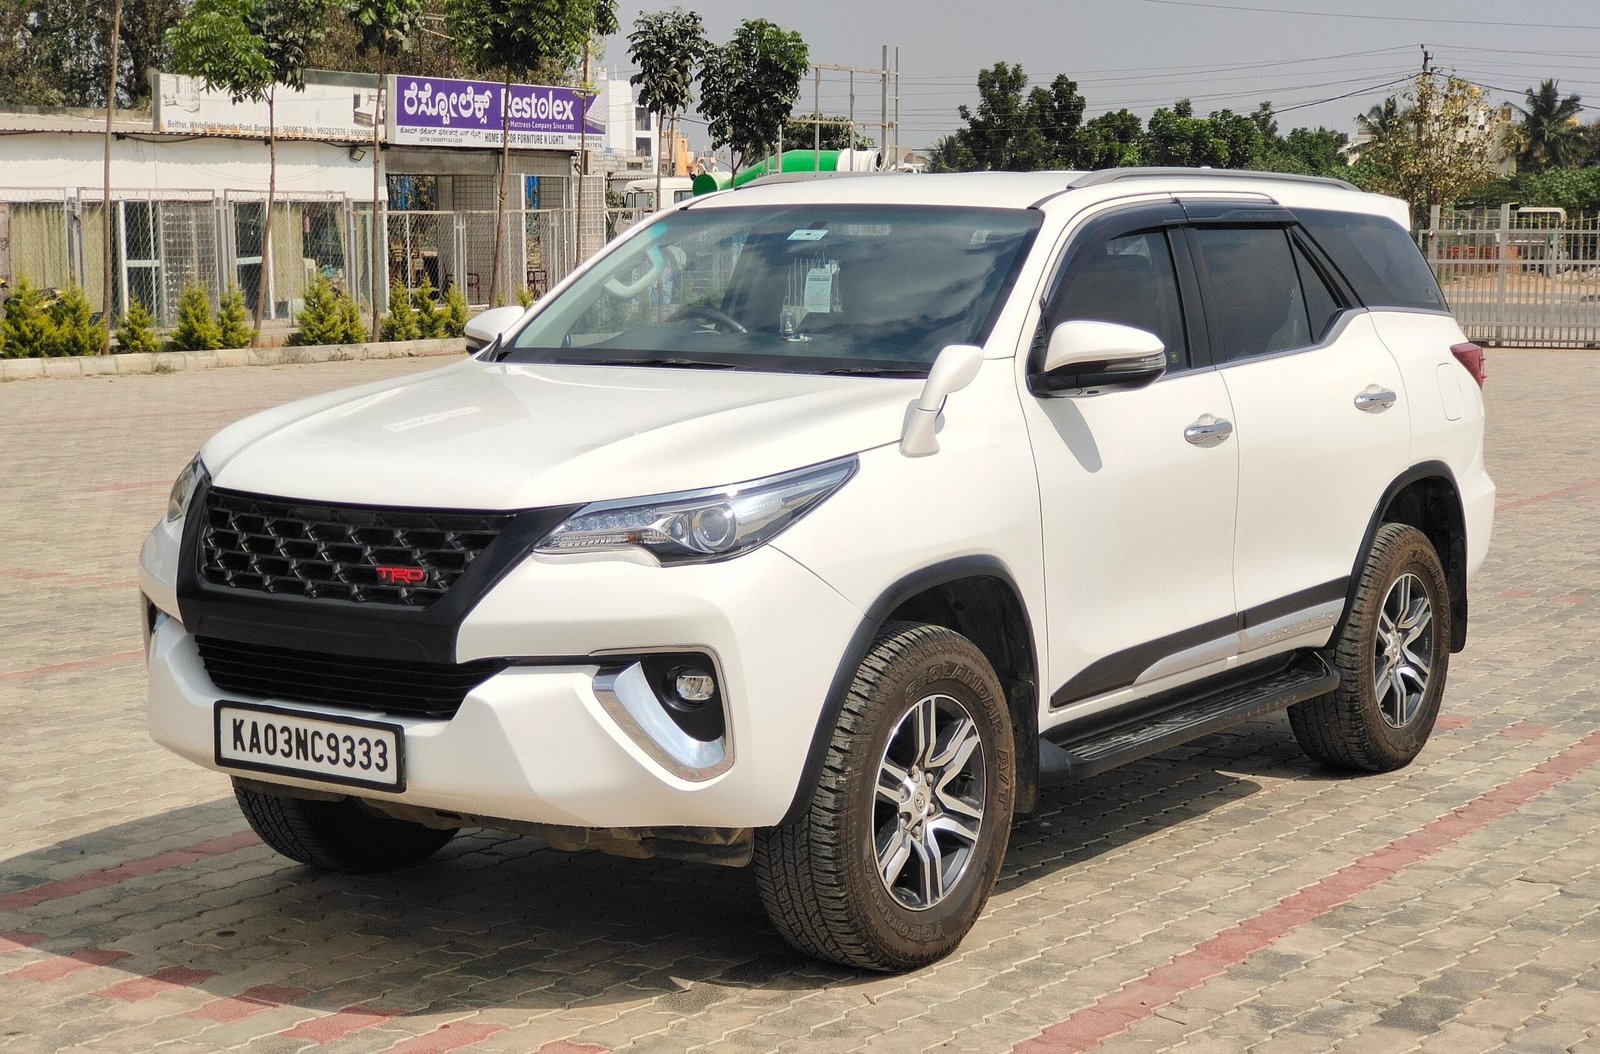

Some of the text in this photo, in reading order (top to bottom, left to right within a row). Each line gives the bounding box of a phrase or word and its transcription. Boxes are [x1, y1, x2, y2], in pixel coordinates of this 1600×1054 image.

[501, 88, 574, 121] Restolex
[189, 121, 216, 130] Whitefield
[510, 120, 531, 129] Mattress
[531, 121, 552, 131] Company
[485, 133, 499, 143] HOME
[500, 133, 516, 143] DOR
[517, 134, 543, 144] FURNITURE
[548, 136, 564, 145] LIGHTS
[376, 566, 426, 584] TRD
[232, 718, 389, 772] KA03NC9333
